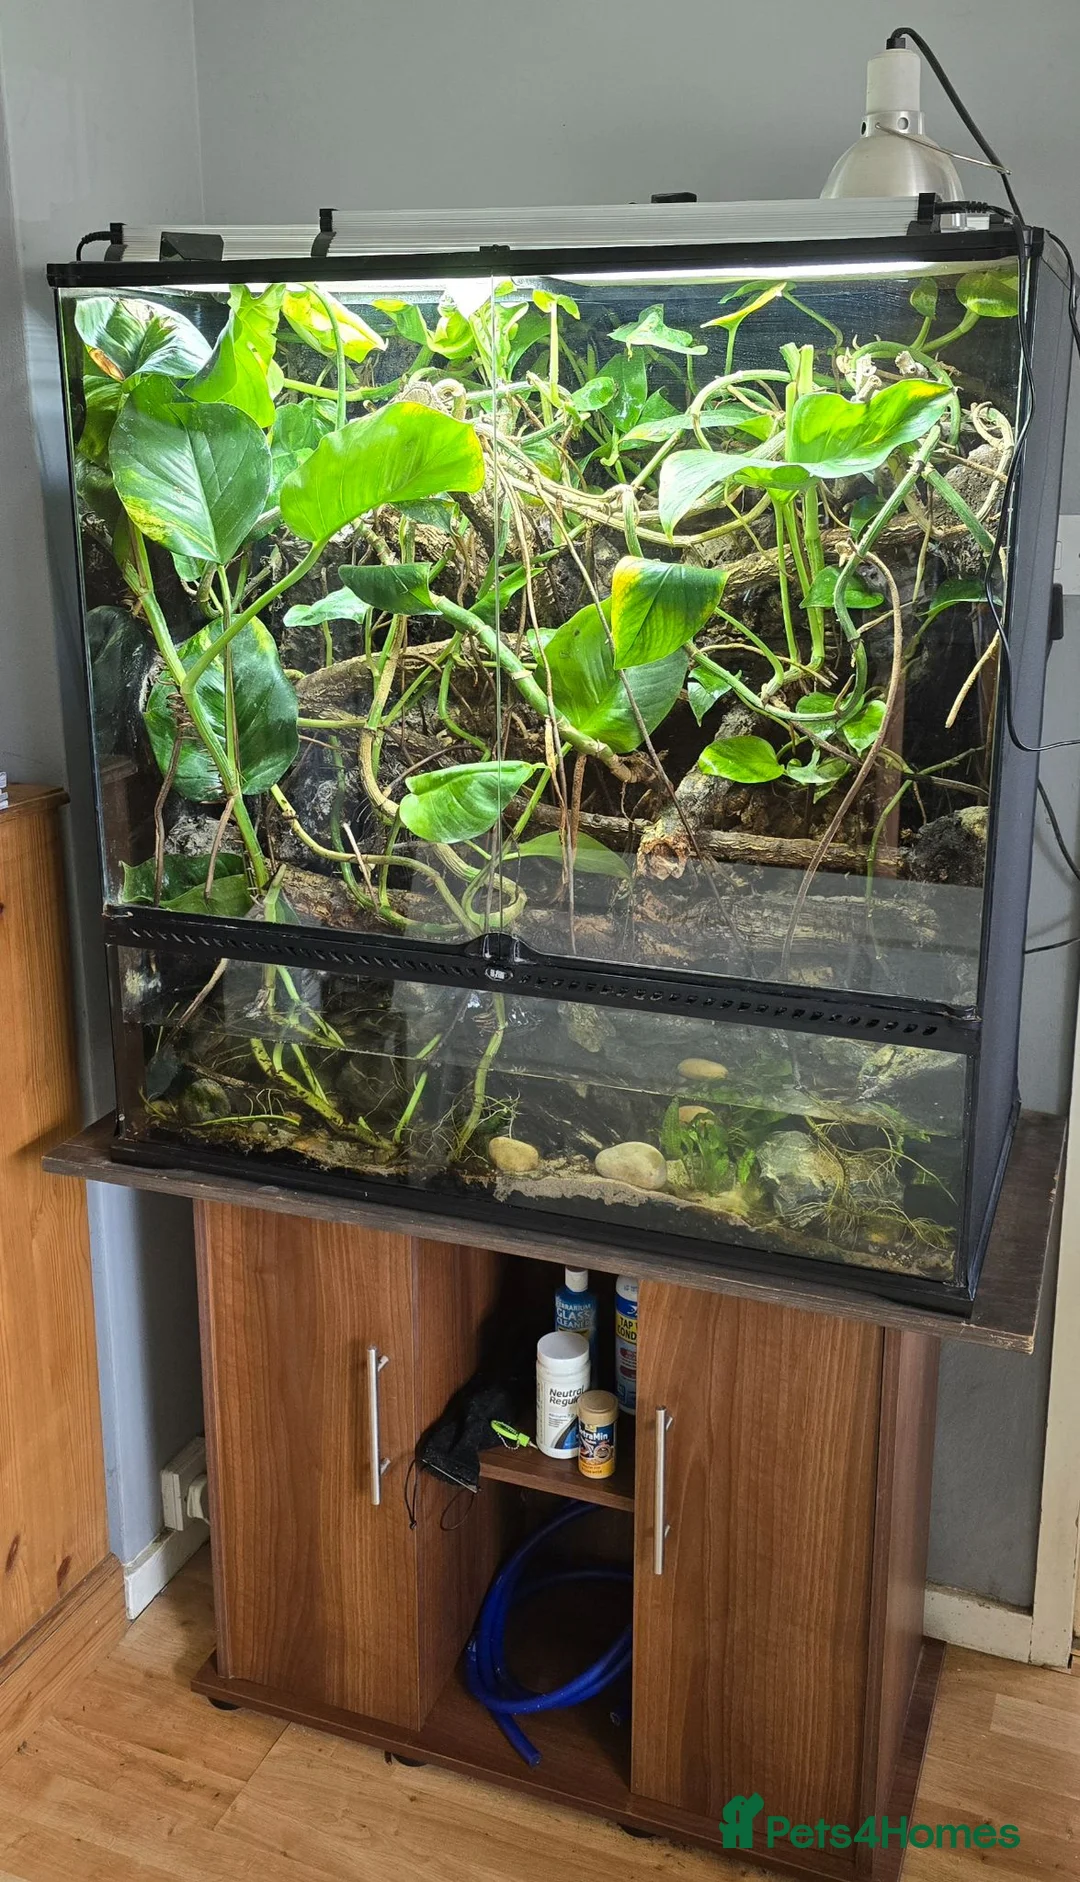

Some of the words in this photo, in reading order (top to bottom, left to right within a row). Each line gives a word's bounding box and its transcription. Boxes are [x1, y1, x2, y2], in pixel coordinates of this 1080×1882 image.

[556, 1300, 591, 1311] ERRARIUM
[556, 1307, 590, 1321] GLASS
[620, 1317, 634, 1330] TAP
[549, 1385, 585, 1398] Neutral
[579, 1429, 608, 1441] etraMin
